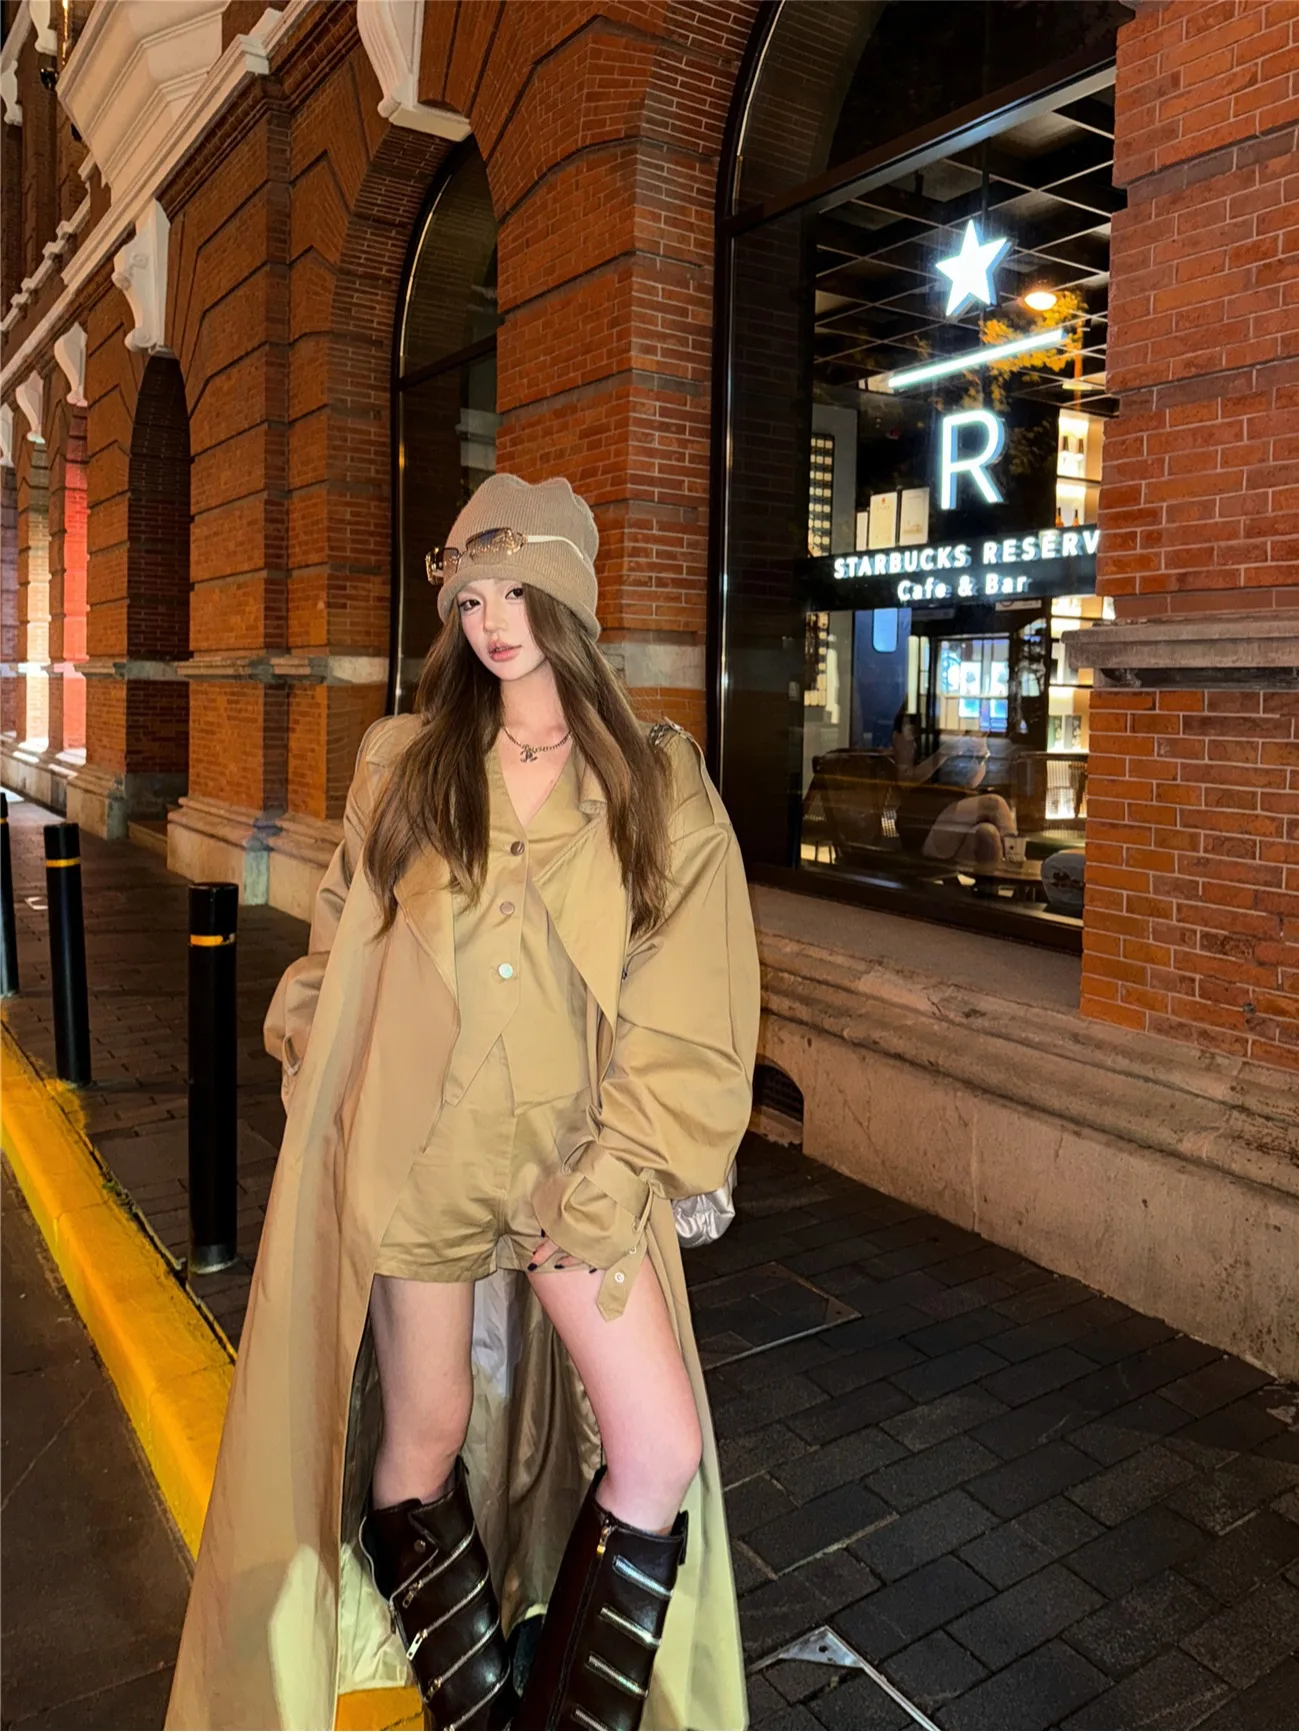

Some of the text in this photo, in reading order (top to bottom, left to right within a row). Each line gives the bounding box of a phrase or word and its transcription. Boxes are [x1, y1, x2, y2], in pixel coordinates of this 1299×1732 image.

[939, 409, 1005, 510] R
[834, 544, 970, 579] STARBUCKS
[897, 572, 1029, 601] Cafe & Bar
